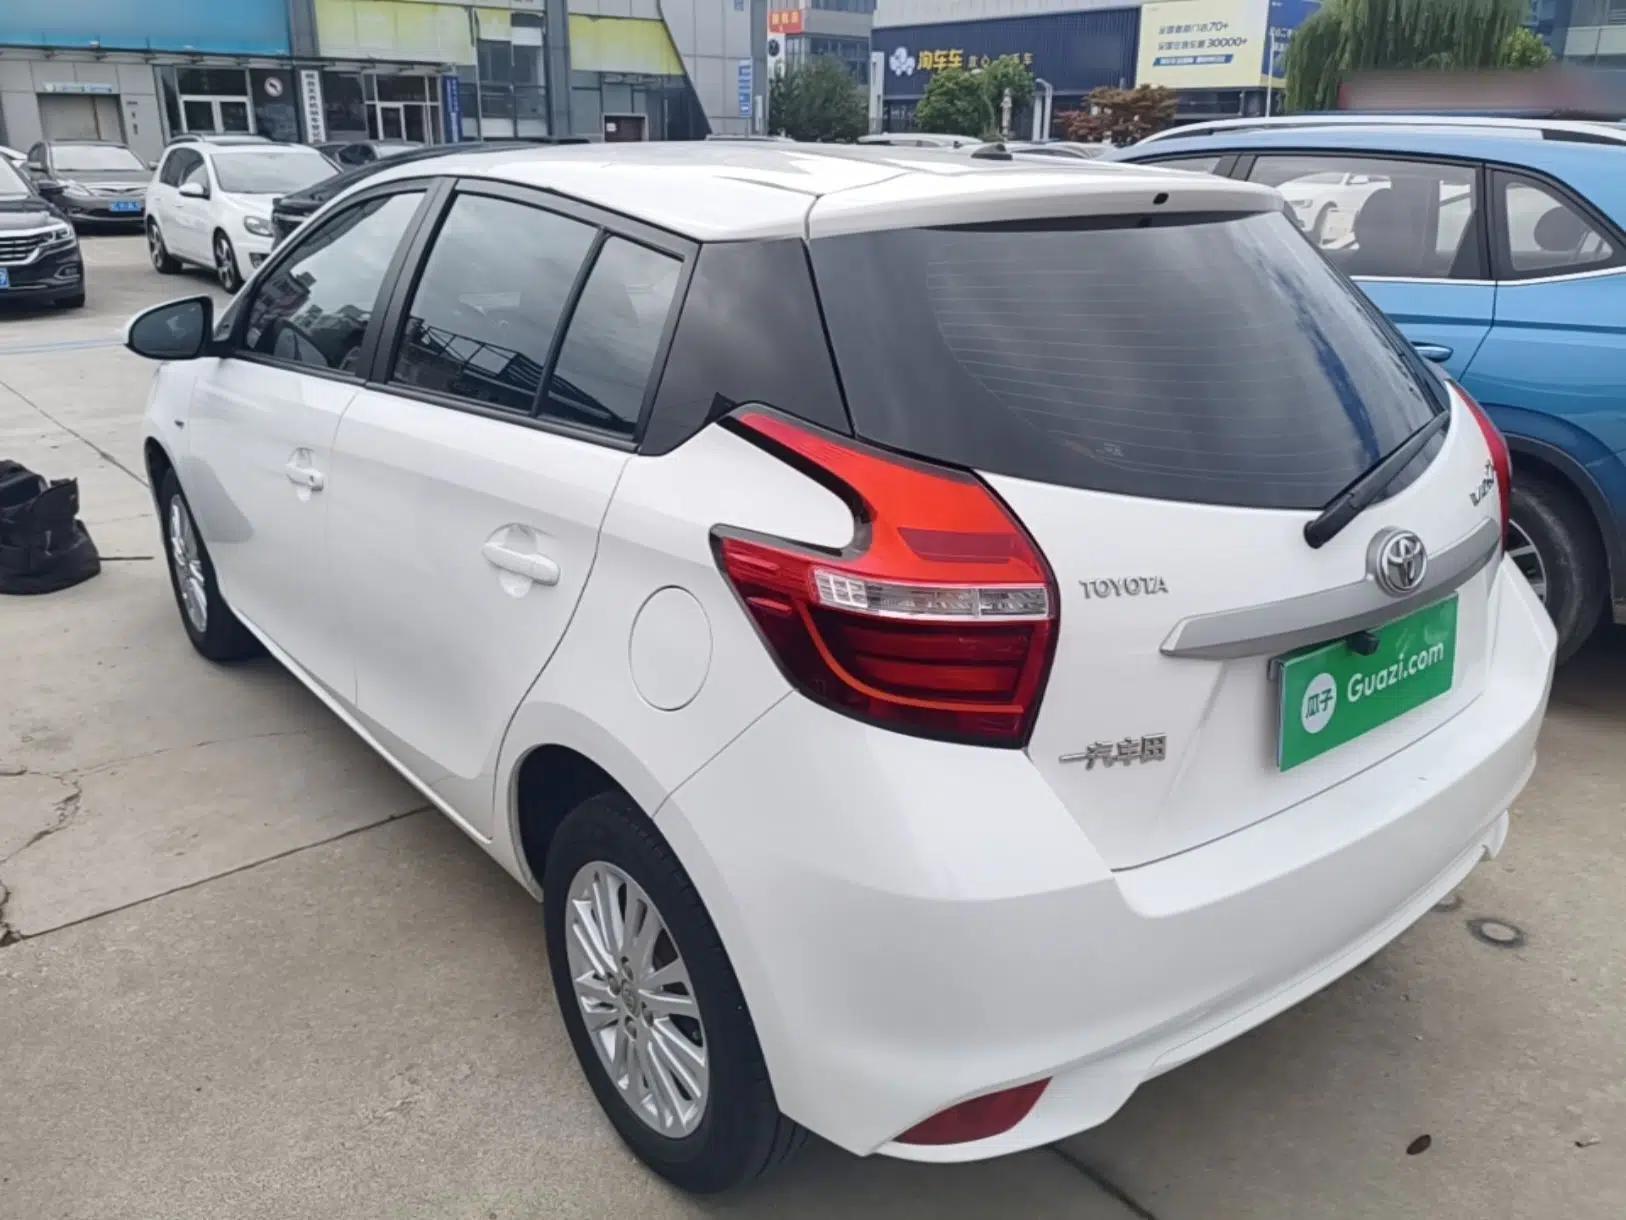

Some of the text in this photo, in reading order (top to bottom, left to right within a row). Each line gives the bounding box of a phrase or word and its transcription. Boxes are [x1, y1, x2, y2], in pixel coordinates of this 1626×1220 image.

[1079, 576, 1169, 599] TOYOTA
[1347, 641, 1444, 703] Guazi.com
[1305, 688, 1334, 719] 瓜子
[1058, 733, 1168, 771] 一汽丰田
